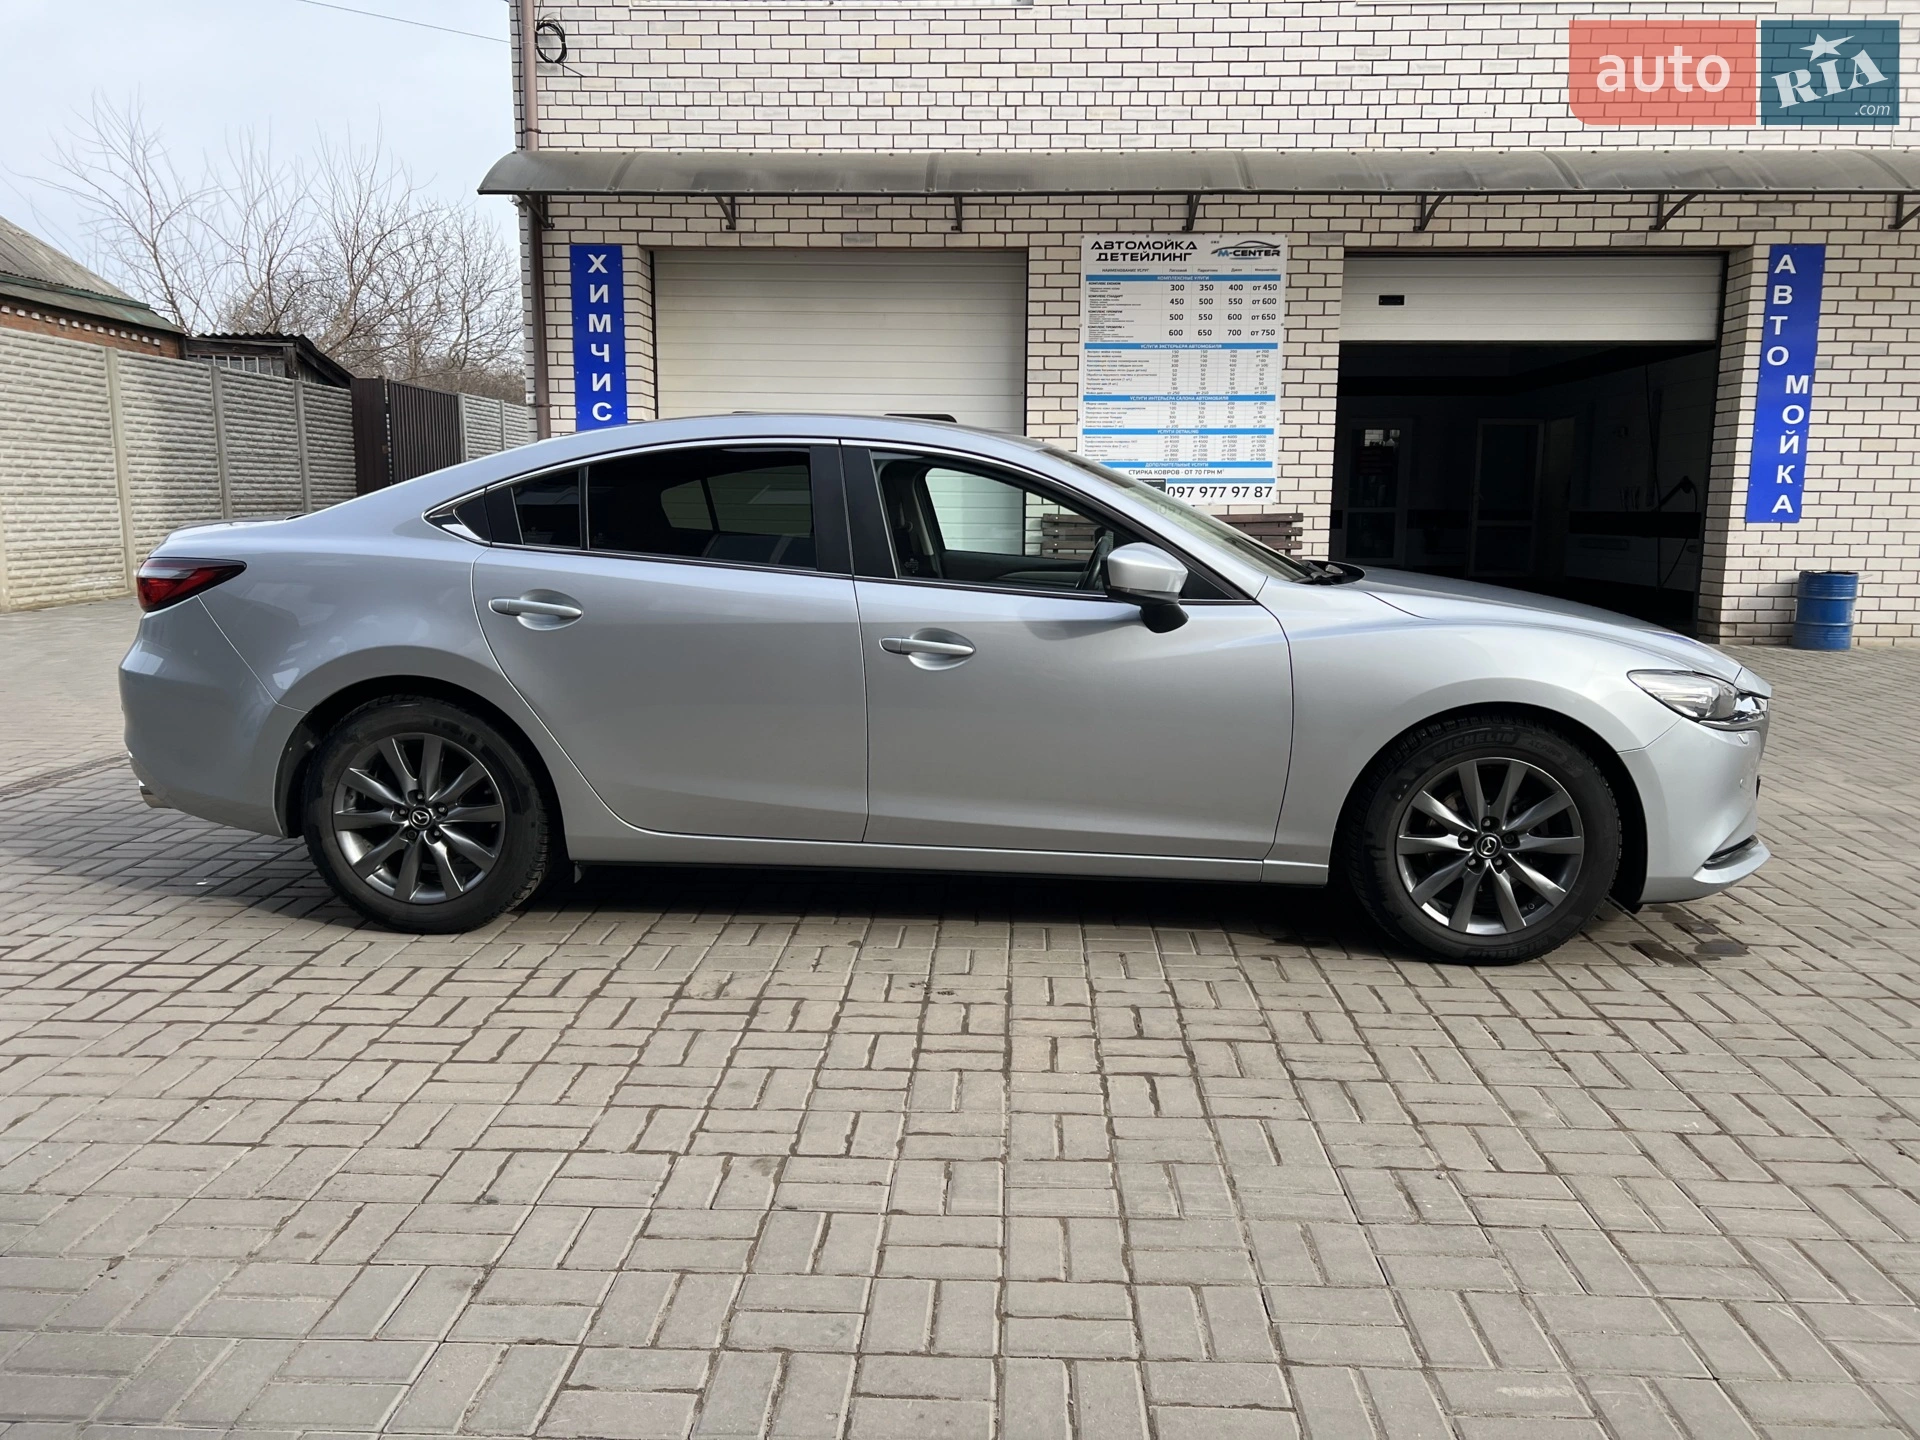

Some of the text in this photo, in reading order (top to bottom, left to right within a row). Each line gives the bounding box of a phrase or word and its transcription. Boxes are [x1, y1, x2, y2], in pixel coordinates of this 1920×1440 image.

[1090, 239, 1197, 250] АВТОМОЙКА
[1096, 251, 1192, 261] ДЕТЕЙЛИНГ
[1217, 249, 1280, 257] M-CENTER
[1167, 486, 1272, 498] 097 977 97 87
